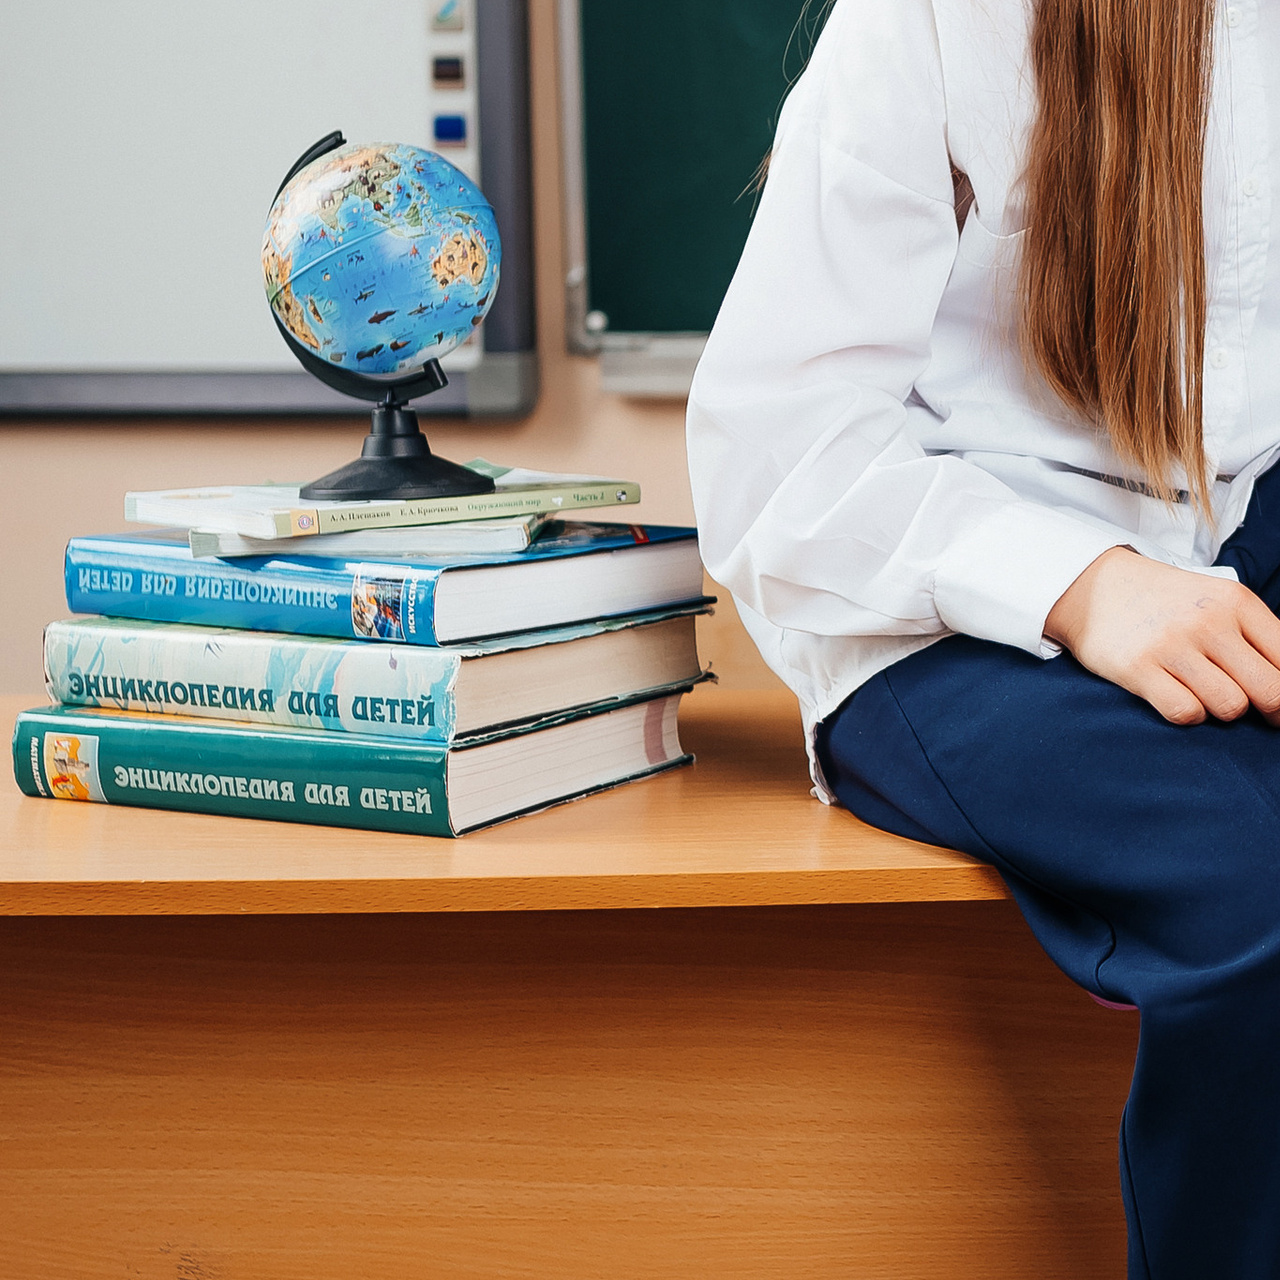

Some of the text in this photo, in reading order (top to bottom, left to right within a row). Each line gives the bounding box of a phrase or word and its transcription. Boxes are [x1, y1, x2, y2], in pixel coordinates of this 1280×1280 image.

[78, 568, 339, 610] ЭНЦИКЛОПЕДИЯ ДЛЯ ДЕТЕЙ
[407, 575, 419, 634] ИСКУССТВО
[68, 673, 435, 727] ЭНЦИКЛОПЕДИЯ ДЛЯ ДЕТЕЙ
[114, 765, 432, 814] ЭНЦИКЛОПЕДИЯ ДЛЯ ДЕТЕЙ
